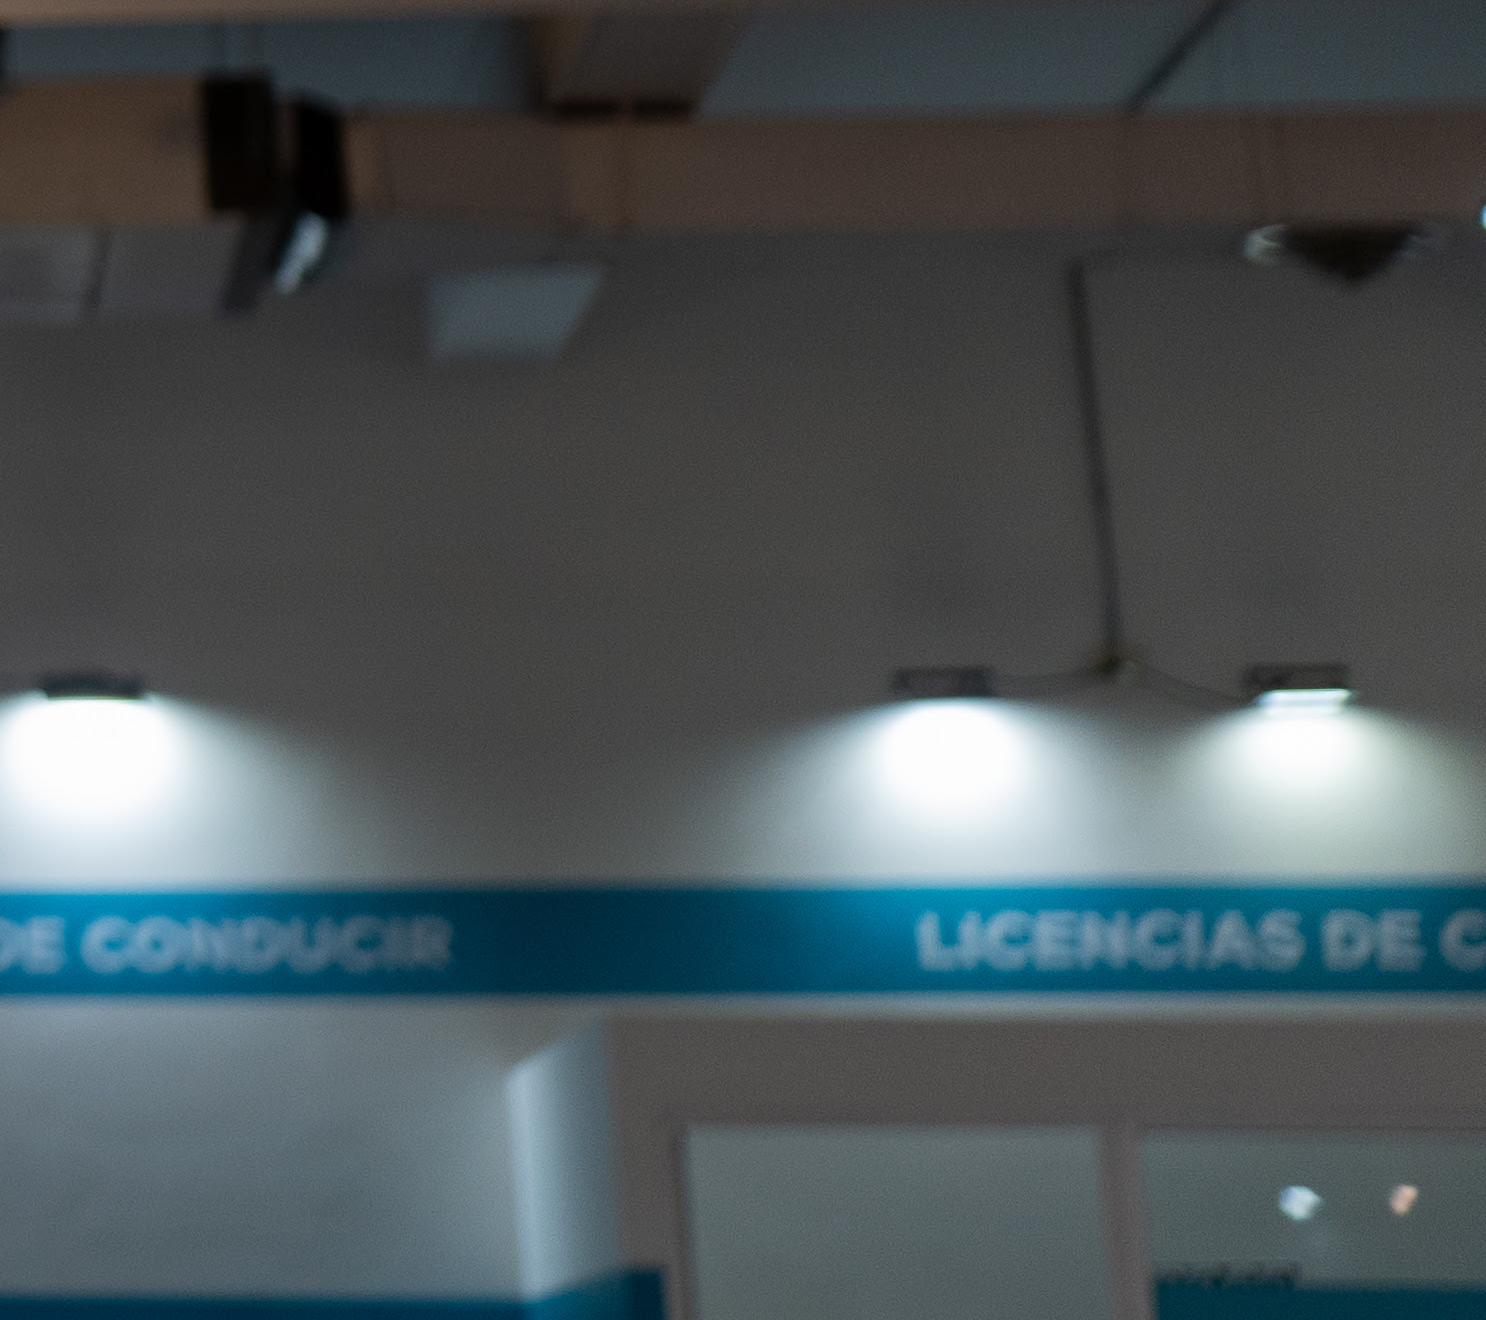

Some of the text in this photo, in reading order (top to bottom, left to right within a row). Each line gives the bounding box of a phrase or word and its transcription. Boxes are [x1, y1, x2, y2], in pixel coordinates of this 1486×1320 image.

[81, 914, 456, 974] CONDUCIR
[916, 908, 1307, 974] LICENCIAS
[1321, 908, 1426, 974] DE
